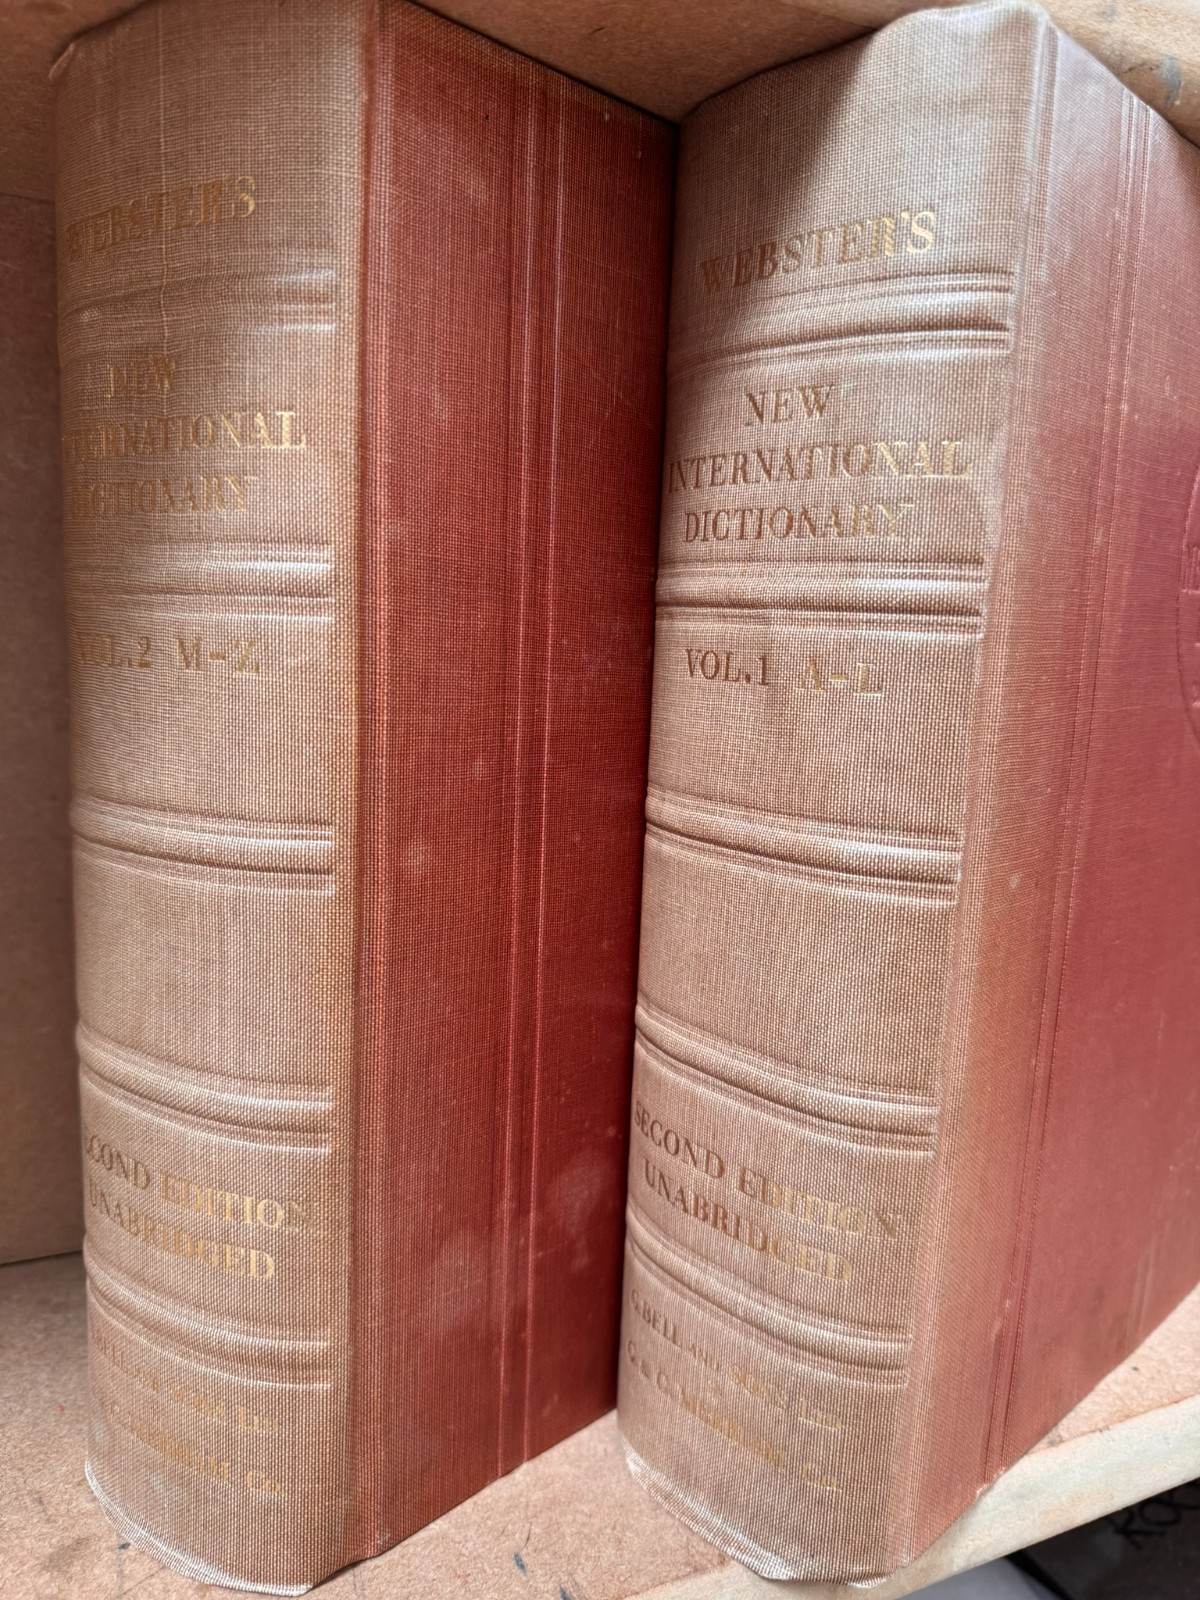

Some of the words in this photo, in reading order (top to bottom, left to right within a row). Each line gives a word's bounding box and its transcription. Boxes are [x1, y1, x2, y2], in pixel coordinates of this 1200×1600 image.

[699, 211, 936, 294] WEBSTER'S
[744, 384, 835, 427] NEW
[668, 441, 973, 494] INTERNATIONAL
[683, 503, 914, 544] DICTIONARY
[685, 649, 770, 687] VOL.1
[160, 1169, 319, 1232] EDITION
[642, 1157, 853, 1282] UNABRIDGED
[738, 1163, 902, 1239] EDITION
